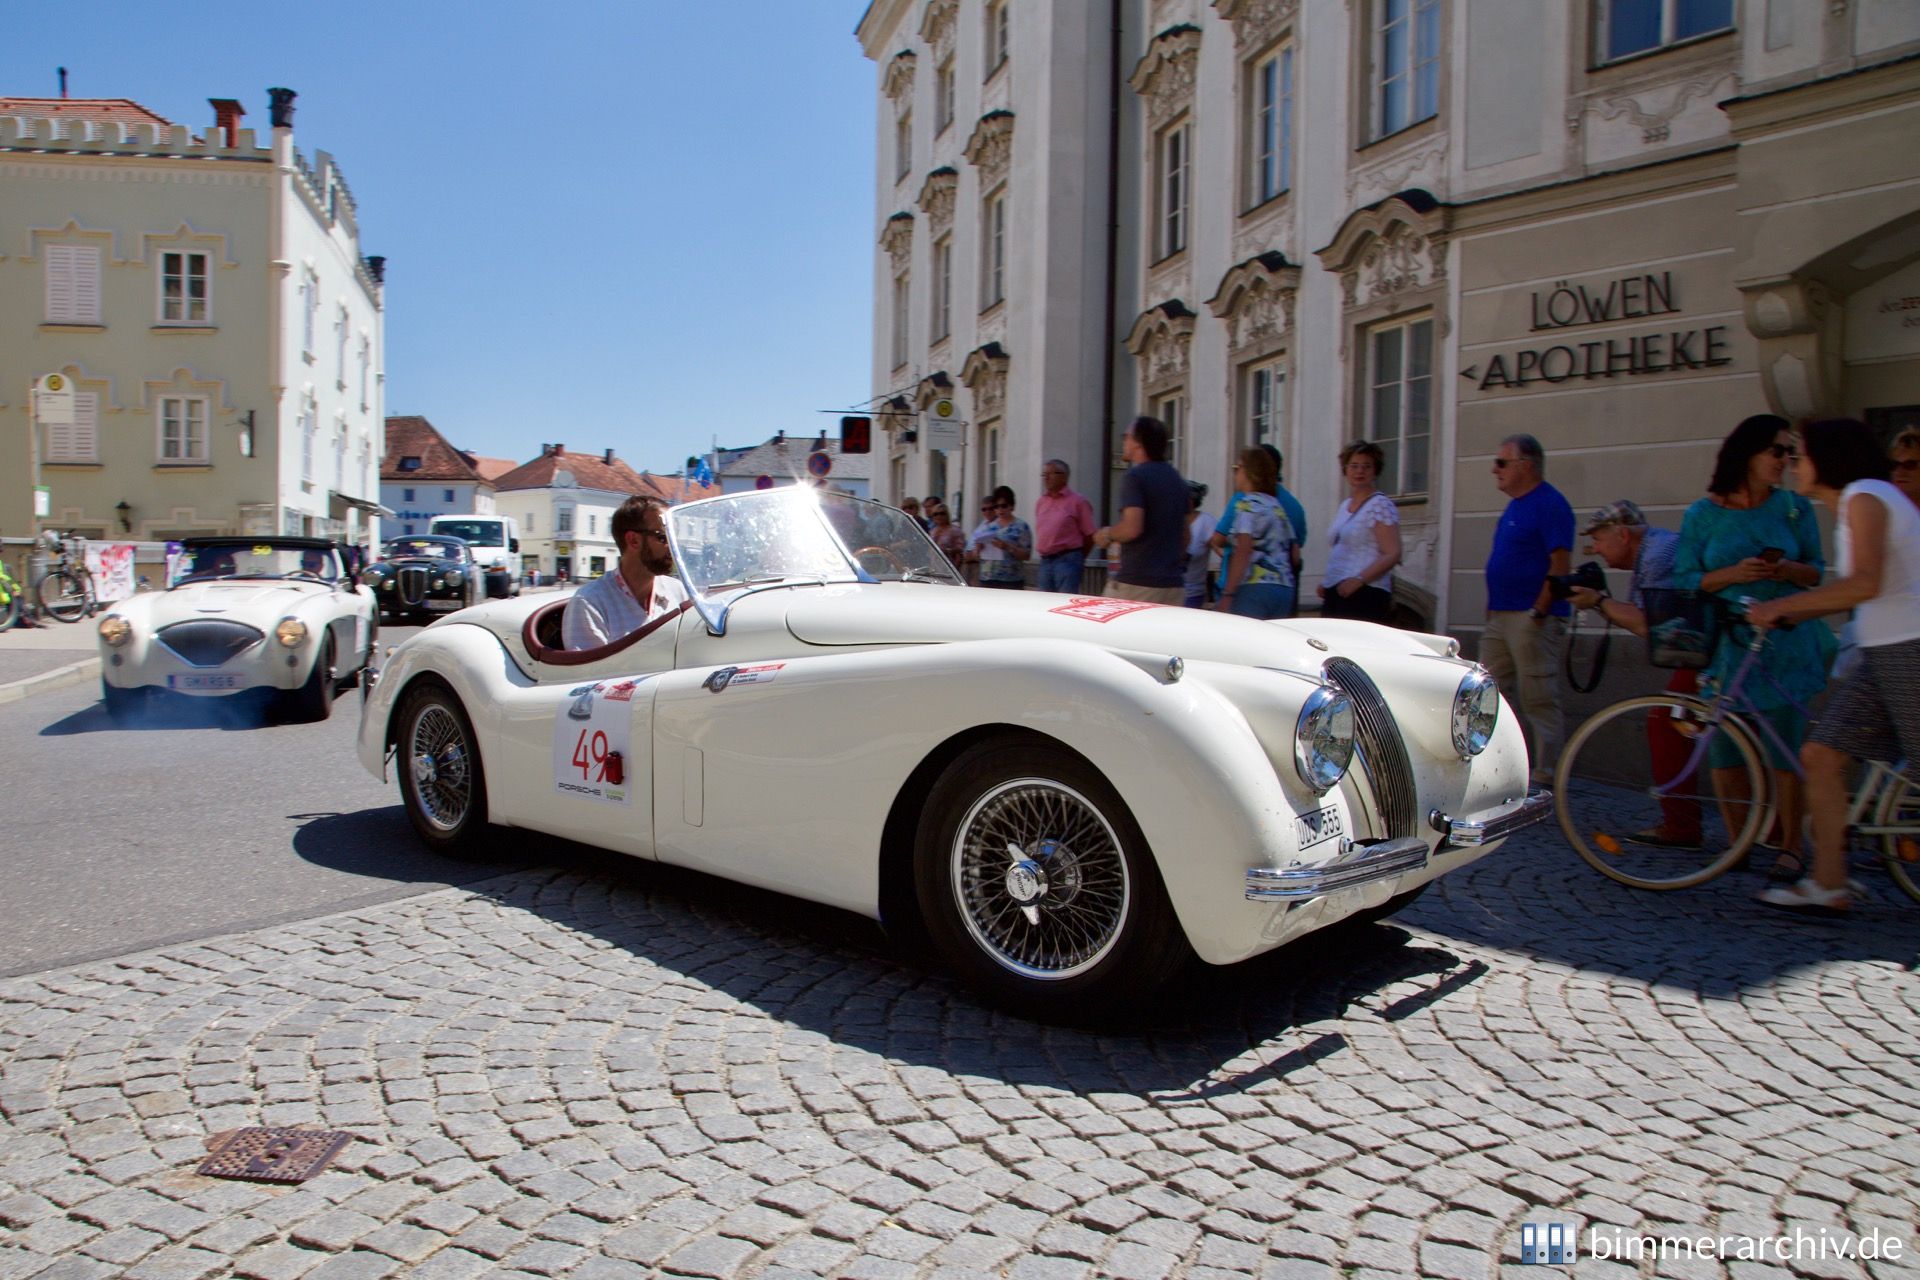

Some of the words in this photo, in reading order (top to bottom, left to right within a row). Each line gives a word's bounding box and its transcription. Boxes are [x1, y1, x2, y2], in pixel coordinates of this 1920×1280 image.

[1530, 271, 1677, 331] LÖWEN
[1478, 326, 1733, 390] APOTHEKE
[572, 728, 609, 783] 49
[558, 782, 602, 796] PORSCHE
[1297, 816, 1318, 845] UDS
[1321, 808, 1341, 836] 555
